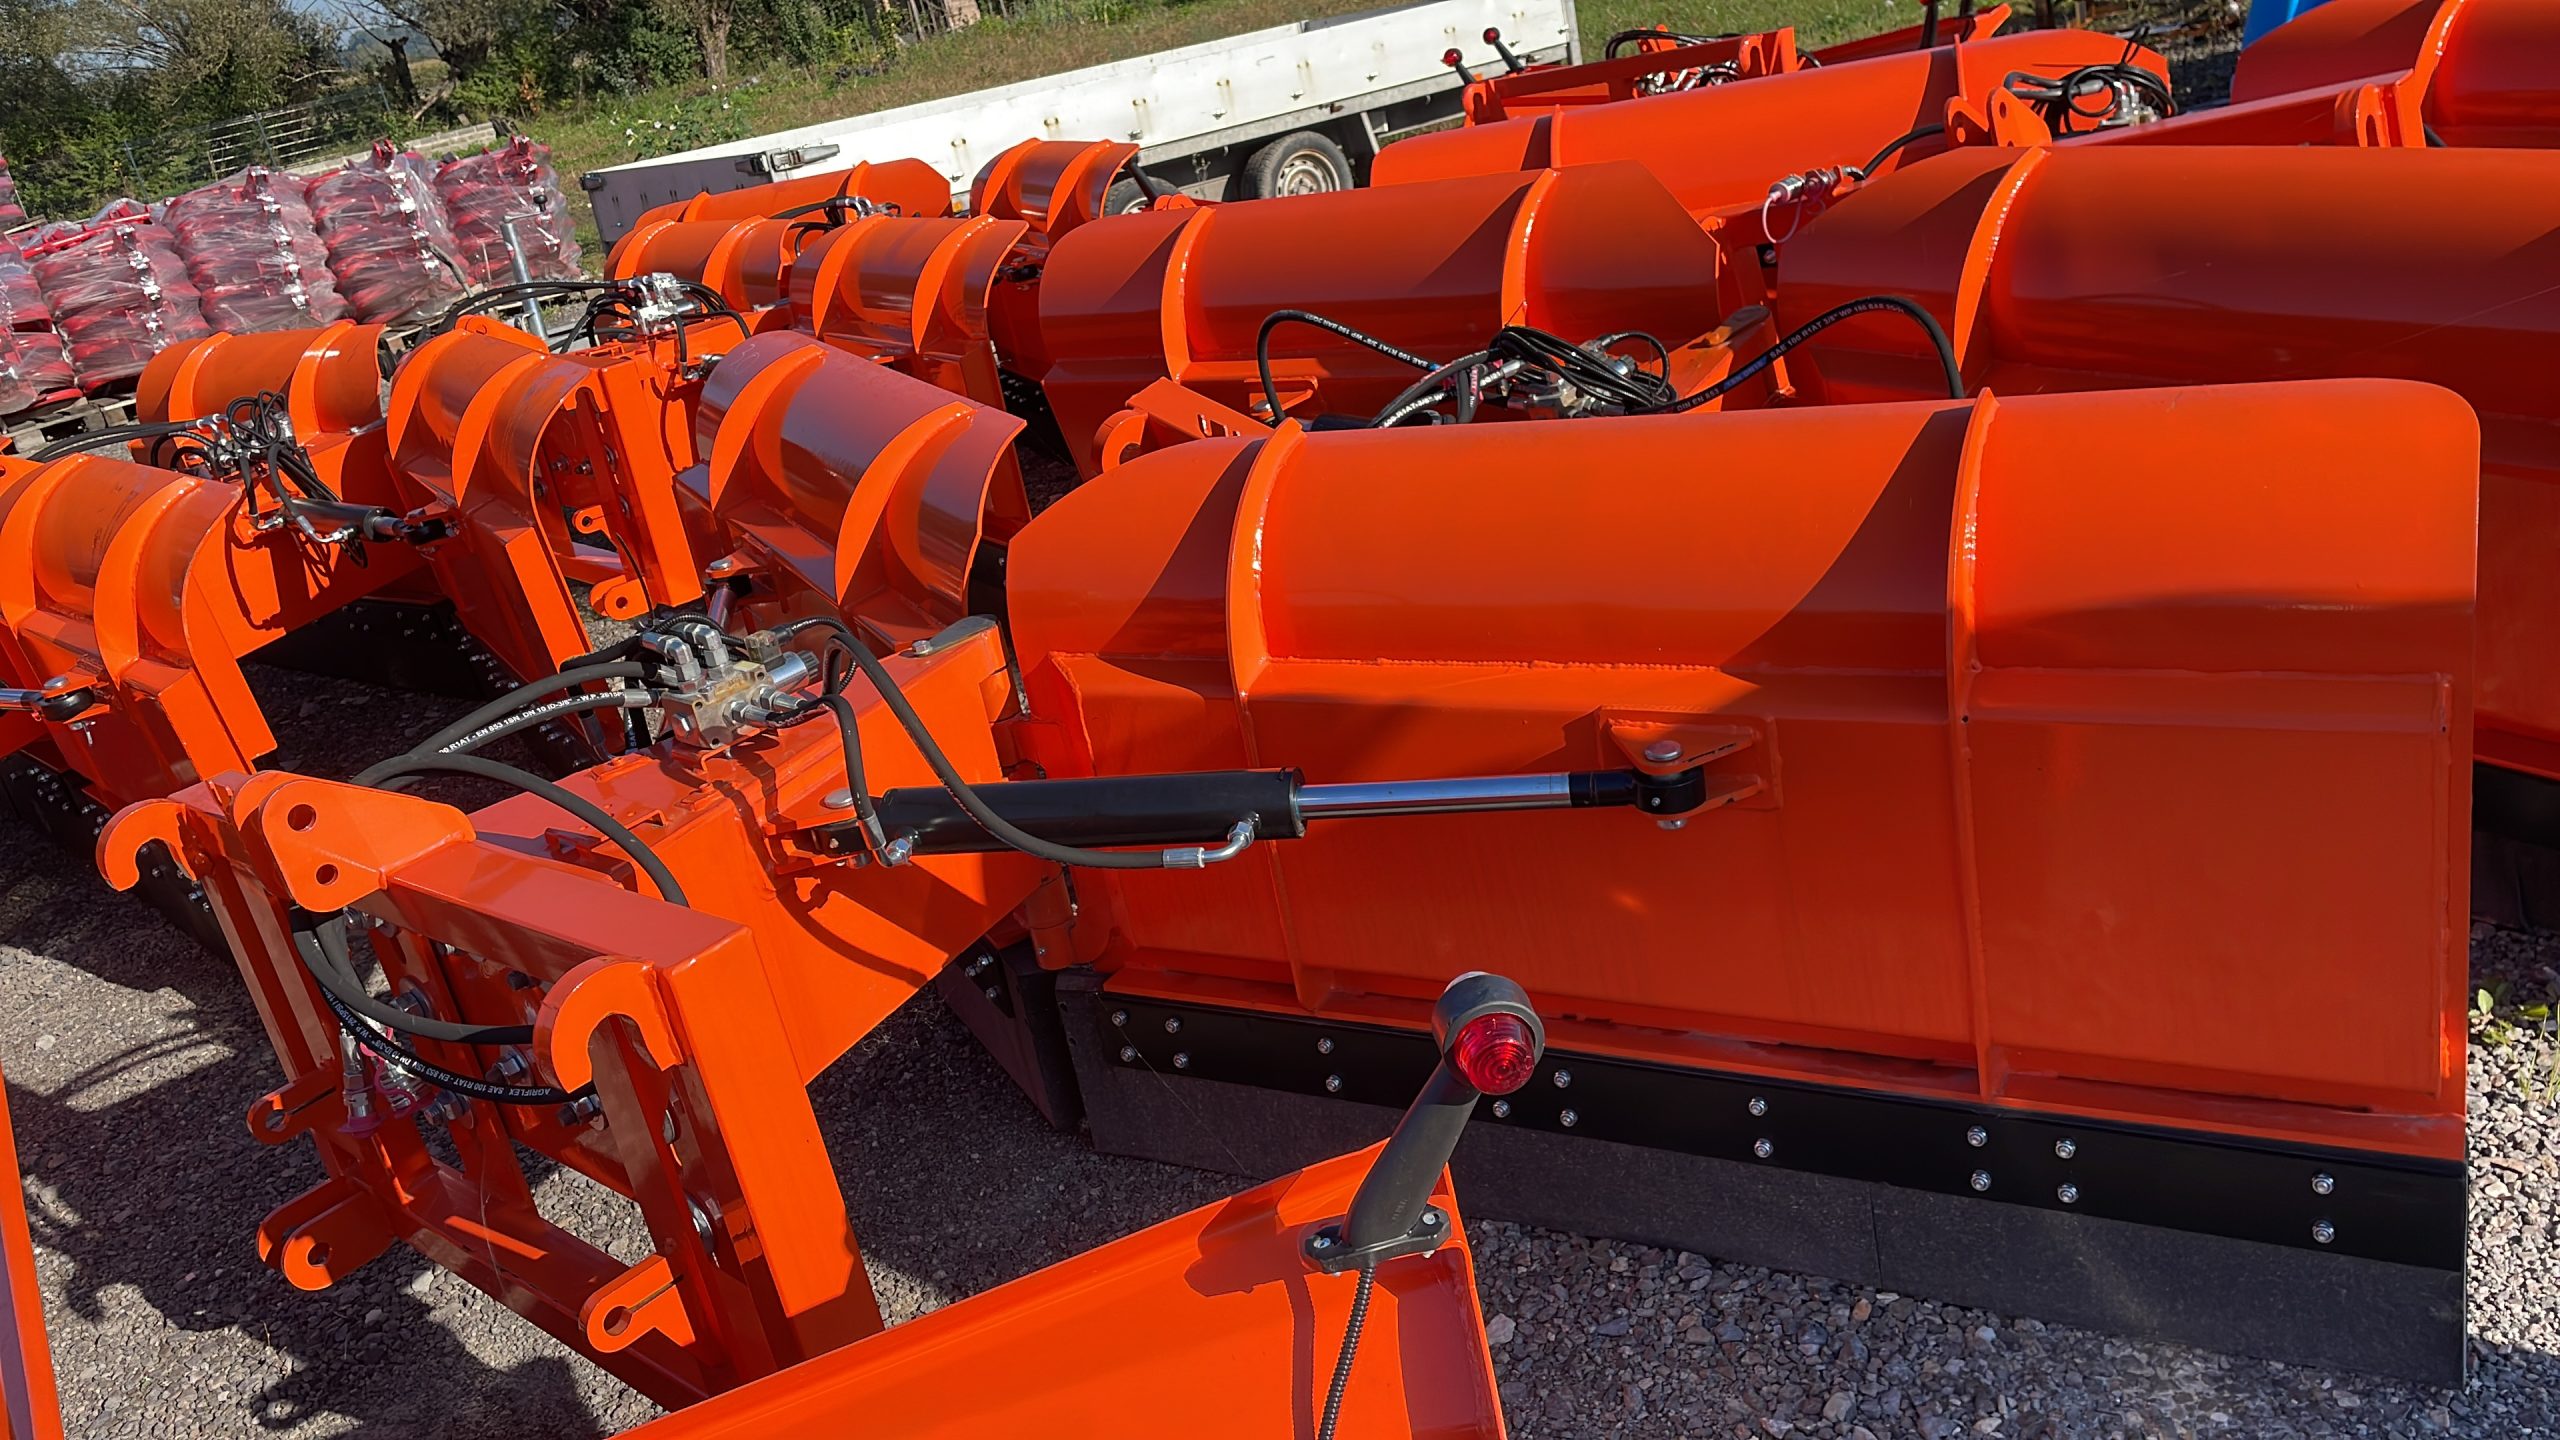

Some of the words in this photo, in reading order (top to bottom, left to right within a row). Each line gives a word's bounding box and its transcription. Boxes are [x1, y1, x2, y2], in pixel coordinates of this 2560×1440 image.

[449, 736, 472, 750] R1AT
[476, 727, 488, 738] EN
[523, 708, 535, 719] DN
[537, 706, 547, 714] 10
[438, 1073, 450, 1082] EN
[453, 1078, 474, 1091] R1AT
[473, 1083, 487, 1092] 100
[487, 1085, 505, 1095] SAE
[508, 1087, 551, 1097] AGRIFLEX
